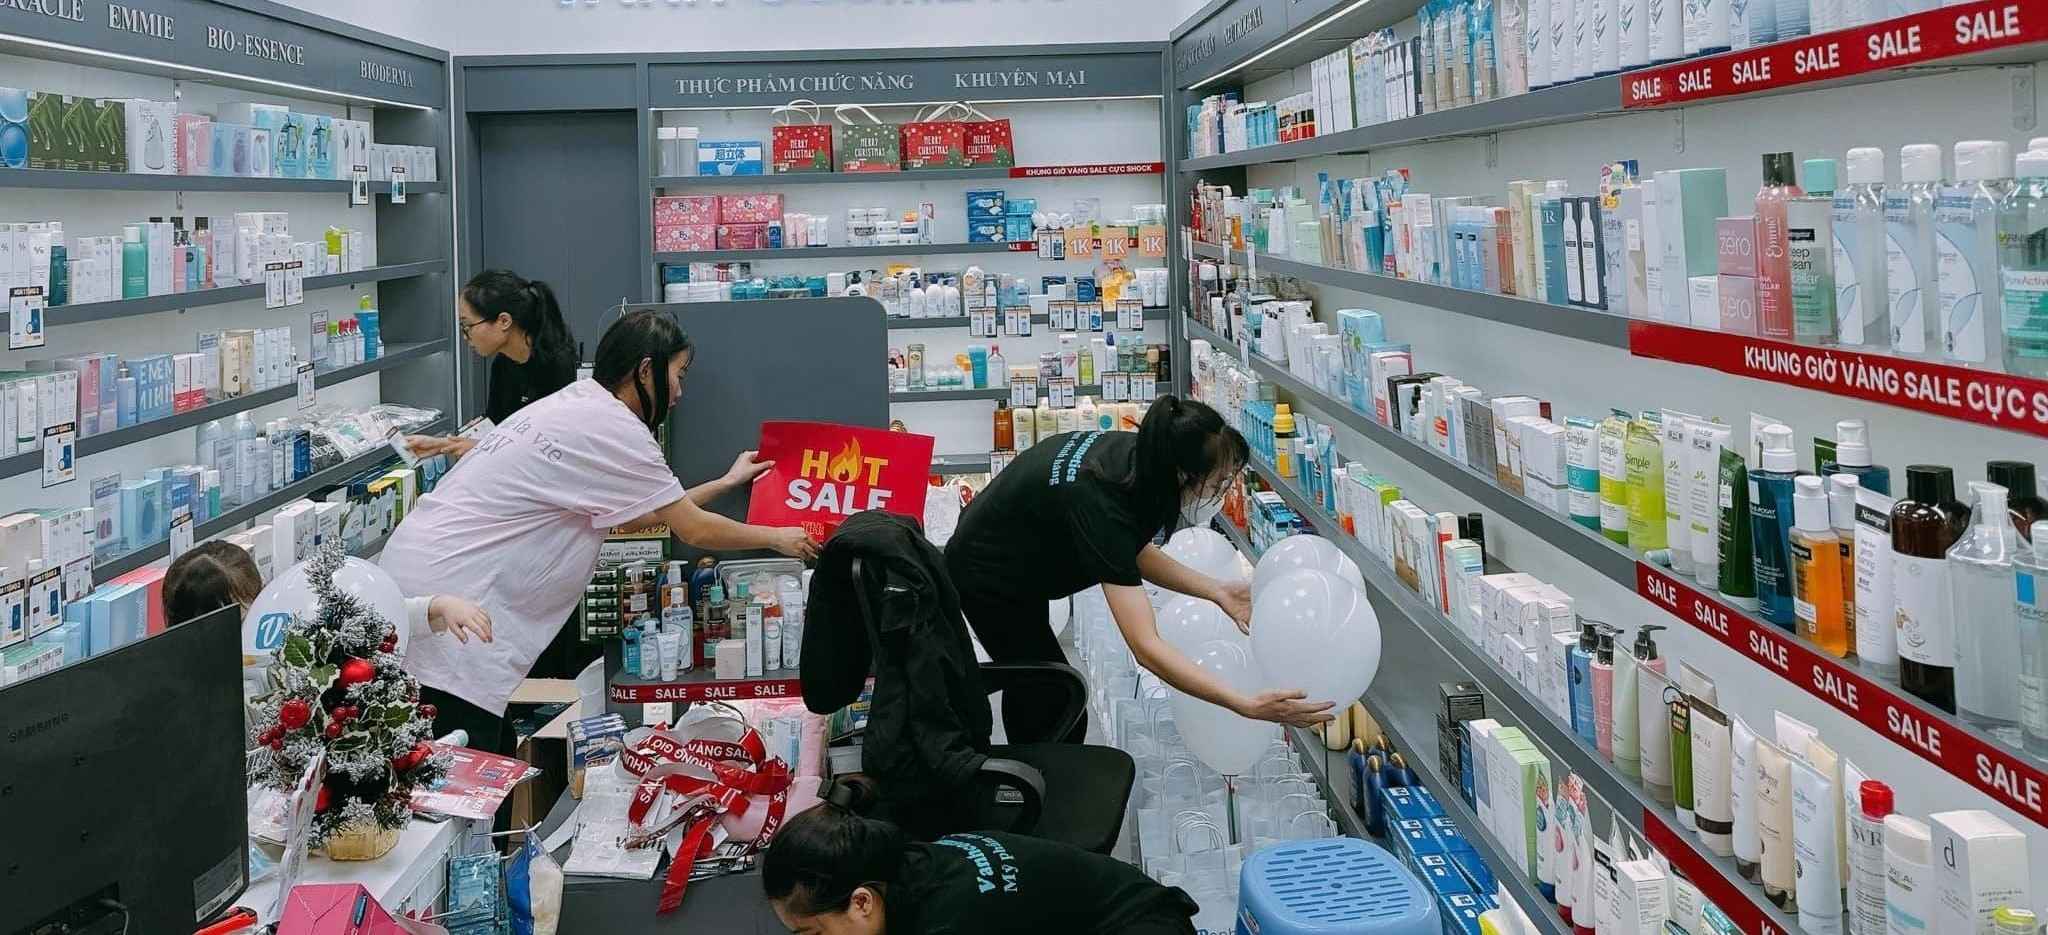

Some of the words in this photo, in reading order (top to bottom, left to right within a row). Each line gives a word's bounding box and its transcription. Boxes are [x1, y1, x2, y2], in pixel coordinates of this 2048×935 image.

[0, 0, 84, 21] ACLE
[109, 4, 175, 40] EMMIE
[1632, 78, 1661, 100] SALE
[1678, 68, 1712, 93] SALE
[1732, 57, 1771, 84] SALE
[1795, 43, 1840, 74] SALE
[1868, 25, 1921, 60] SALE
[1955, 6, 2020, 44] SALE
[360, 60, 413, 88] BIODERMA
[1047, 70, 1088, 89] MẠI
[675, 77, 731, 98] THỰC
[859, 71, 914, 90] NĂNG
[790, 139, 808, 149] MERRY
[860, 138, 878, 147] MERRY
[923, 135, 942, 145] MERRY
[784, 149, 815, 159] CHRISTMAS
[854, 147, 886, 157] CHRISTMAS
[918, 145, 949, 155] CHRISTMAS
[1090, 166, 1108, 174] SALE
[1071, 238, 1089, 254] 1K
[1107, 238, 1126, 254] 1K
[1144, 236, 1161, 252] 1K
[1720, 236, 1751, 256] zero
[1791, 248, 1810, 258] eep
[1720, 296, 1751, 319] zero
[1745, 346, 1800, 376] KHUNG
[1805, 352, 1837, 383] GIỜ
[1841, 356, 1899, 396] VÀNG
[1904, 371, 1961, 407] SALE
[1967, 381, 2026, 422] CỰC
[534, 432, 562, 462] vie
[800, 438, 889, 487] HOT
[1625, 453, 1649, 469] Simple
[785, 479, 893, 516] SALE
[611, 687, 637, 700] SALE
[656, 688, 687, 699] SALE
[705, 686, 736, 697] SALE
[754, 684, 786, 696] SALE
[1647, 574, 1677, 607] SALE
[1695, 600, 1728, 636] SALE
[1749, 630, 1789, 671] SALE
[1813, 664, 1859, 710] SALE
[1887, 705, 1942, 758] SALE
[1976, 753, 2042, 813] SALE
[725, 747, 752, 761] SAL
[757, 815, 778, 849] SALE
